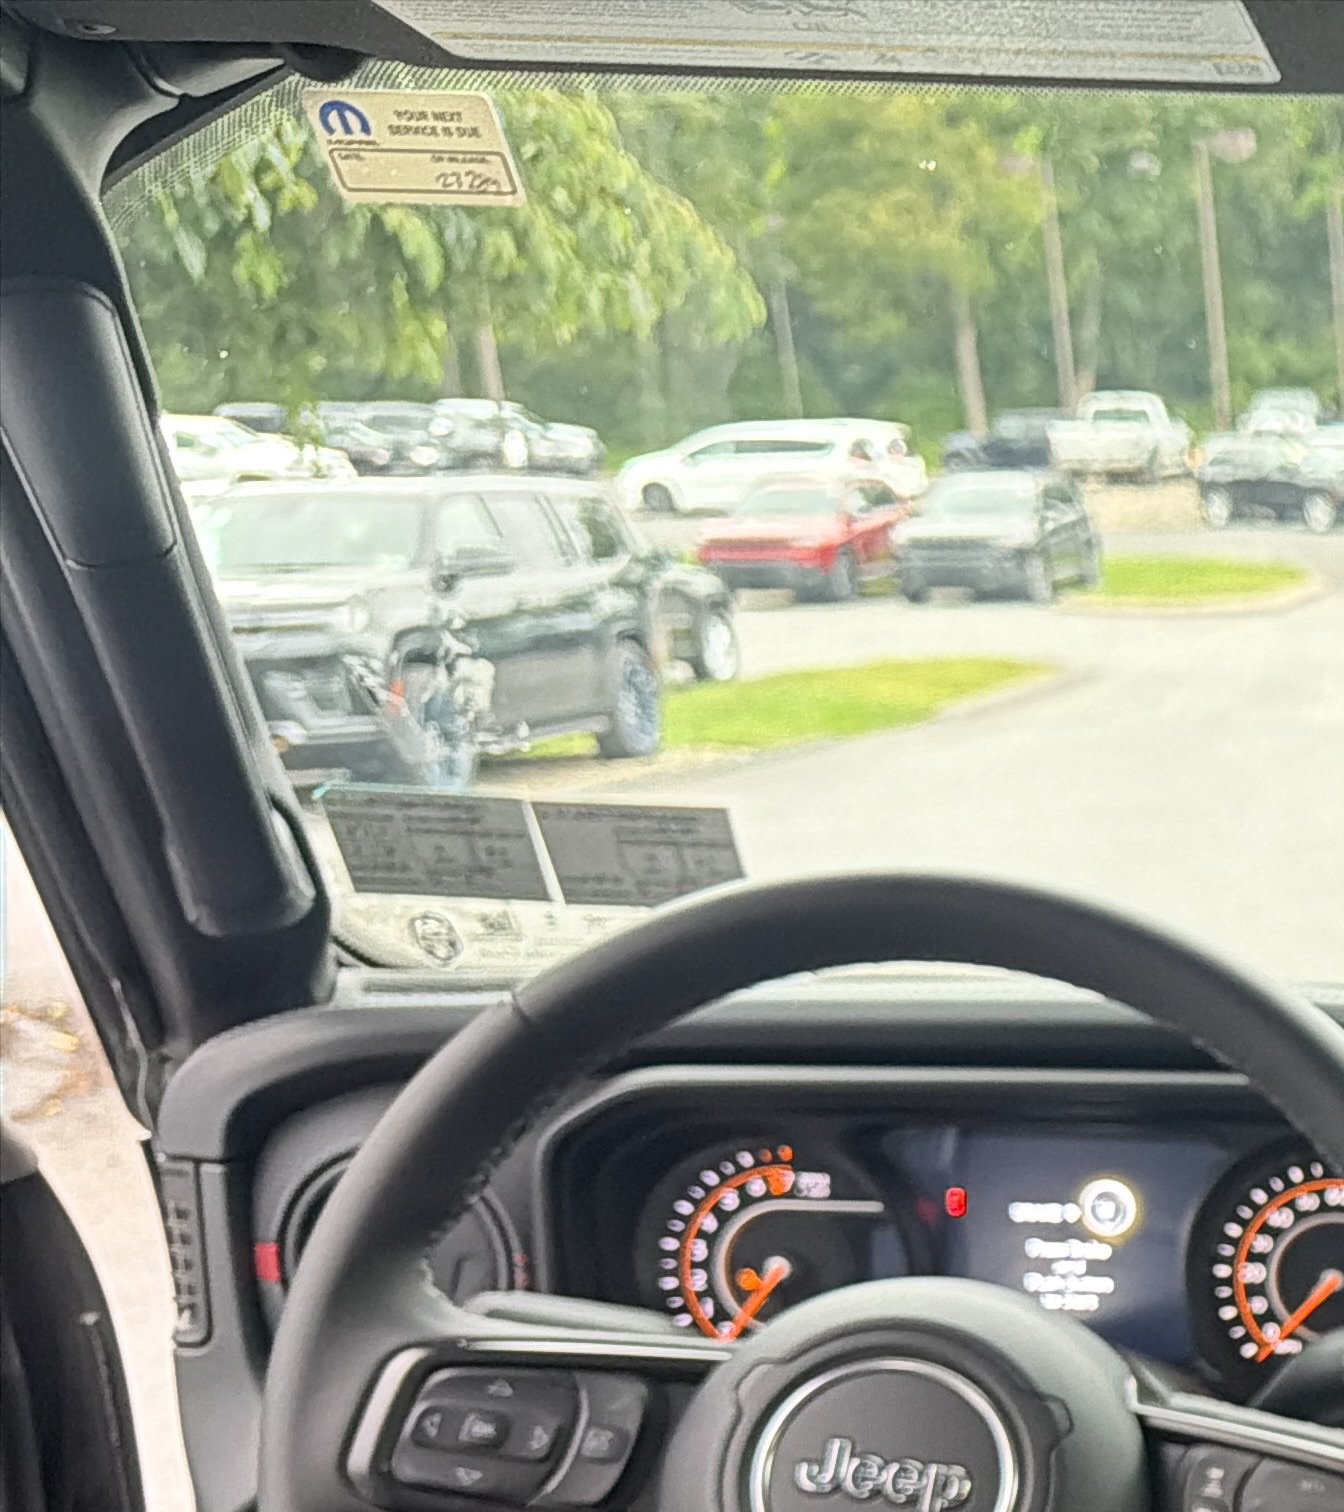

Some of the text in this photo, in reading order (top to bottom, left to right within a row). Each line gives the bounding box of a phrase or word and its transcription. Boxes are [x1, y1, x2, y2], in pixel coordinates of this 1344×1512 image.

[431, 110, 463, 122] NEXT
[387, 124, 439, 137] SERVICE
[453, 125, 483, 138] DUE
